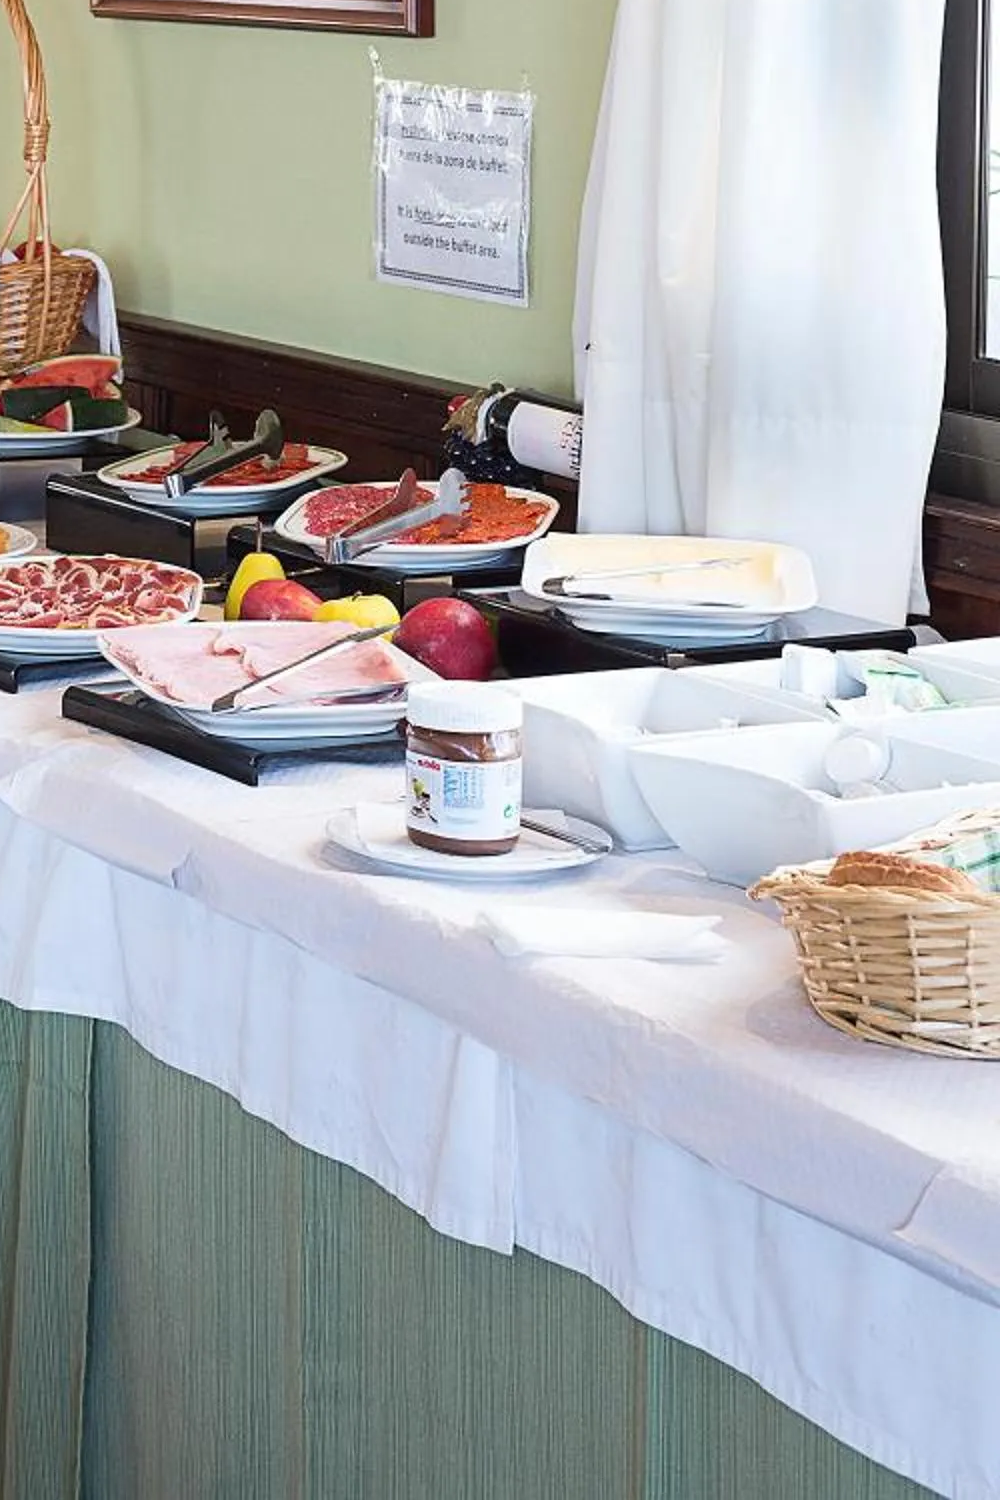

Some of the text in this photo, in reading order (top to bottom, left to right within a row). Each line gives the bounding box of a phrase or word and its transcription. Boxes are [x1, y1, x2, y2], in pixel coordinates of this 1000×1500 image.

[403, 233, 433, 248] outside
[435, 235, 450, 250] the
[452, 237, 477, 255] buffet
